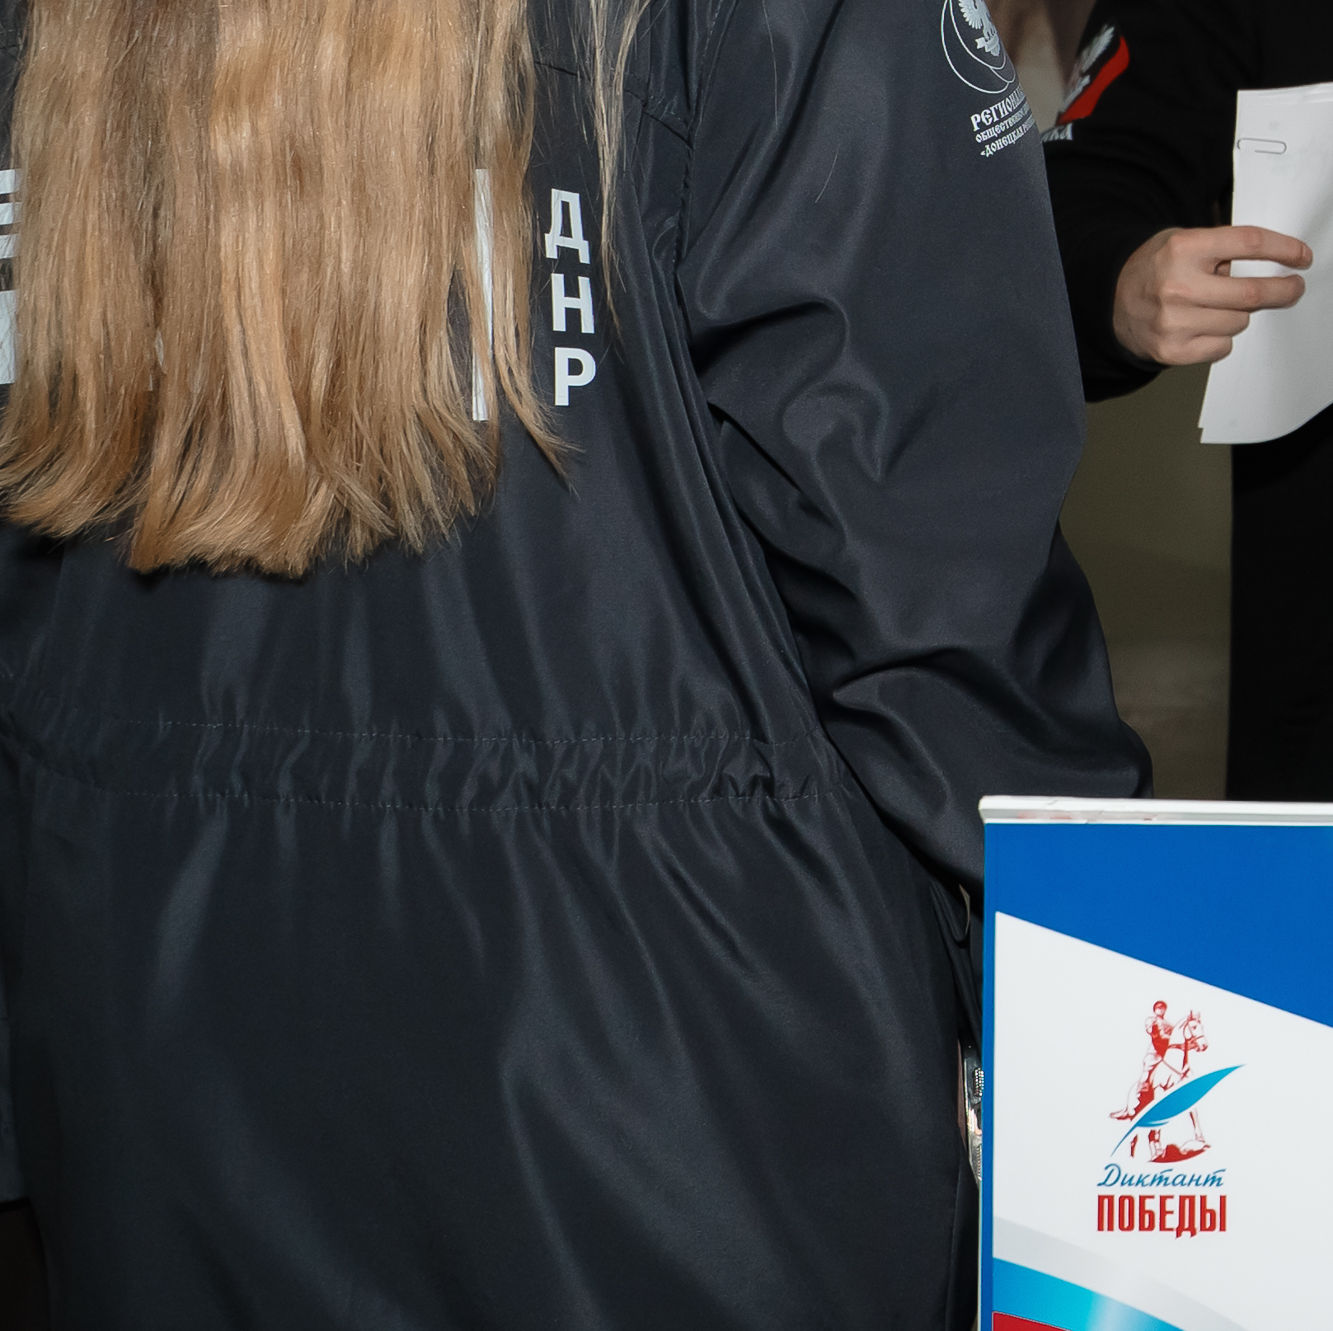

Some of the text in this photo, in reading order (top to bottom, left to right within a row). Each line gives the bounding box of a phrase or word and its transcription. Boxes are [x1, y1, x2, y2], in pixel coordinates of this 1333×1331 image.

[543, 188, 597, 406] ДНР
[1096, 1162, 1227, 1189] Диктант
[1096, 1193, 1227, 1238] ПОБЕДЫ
